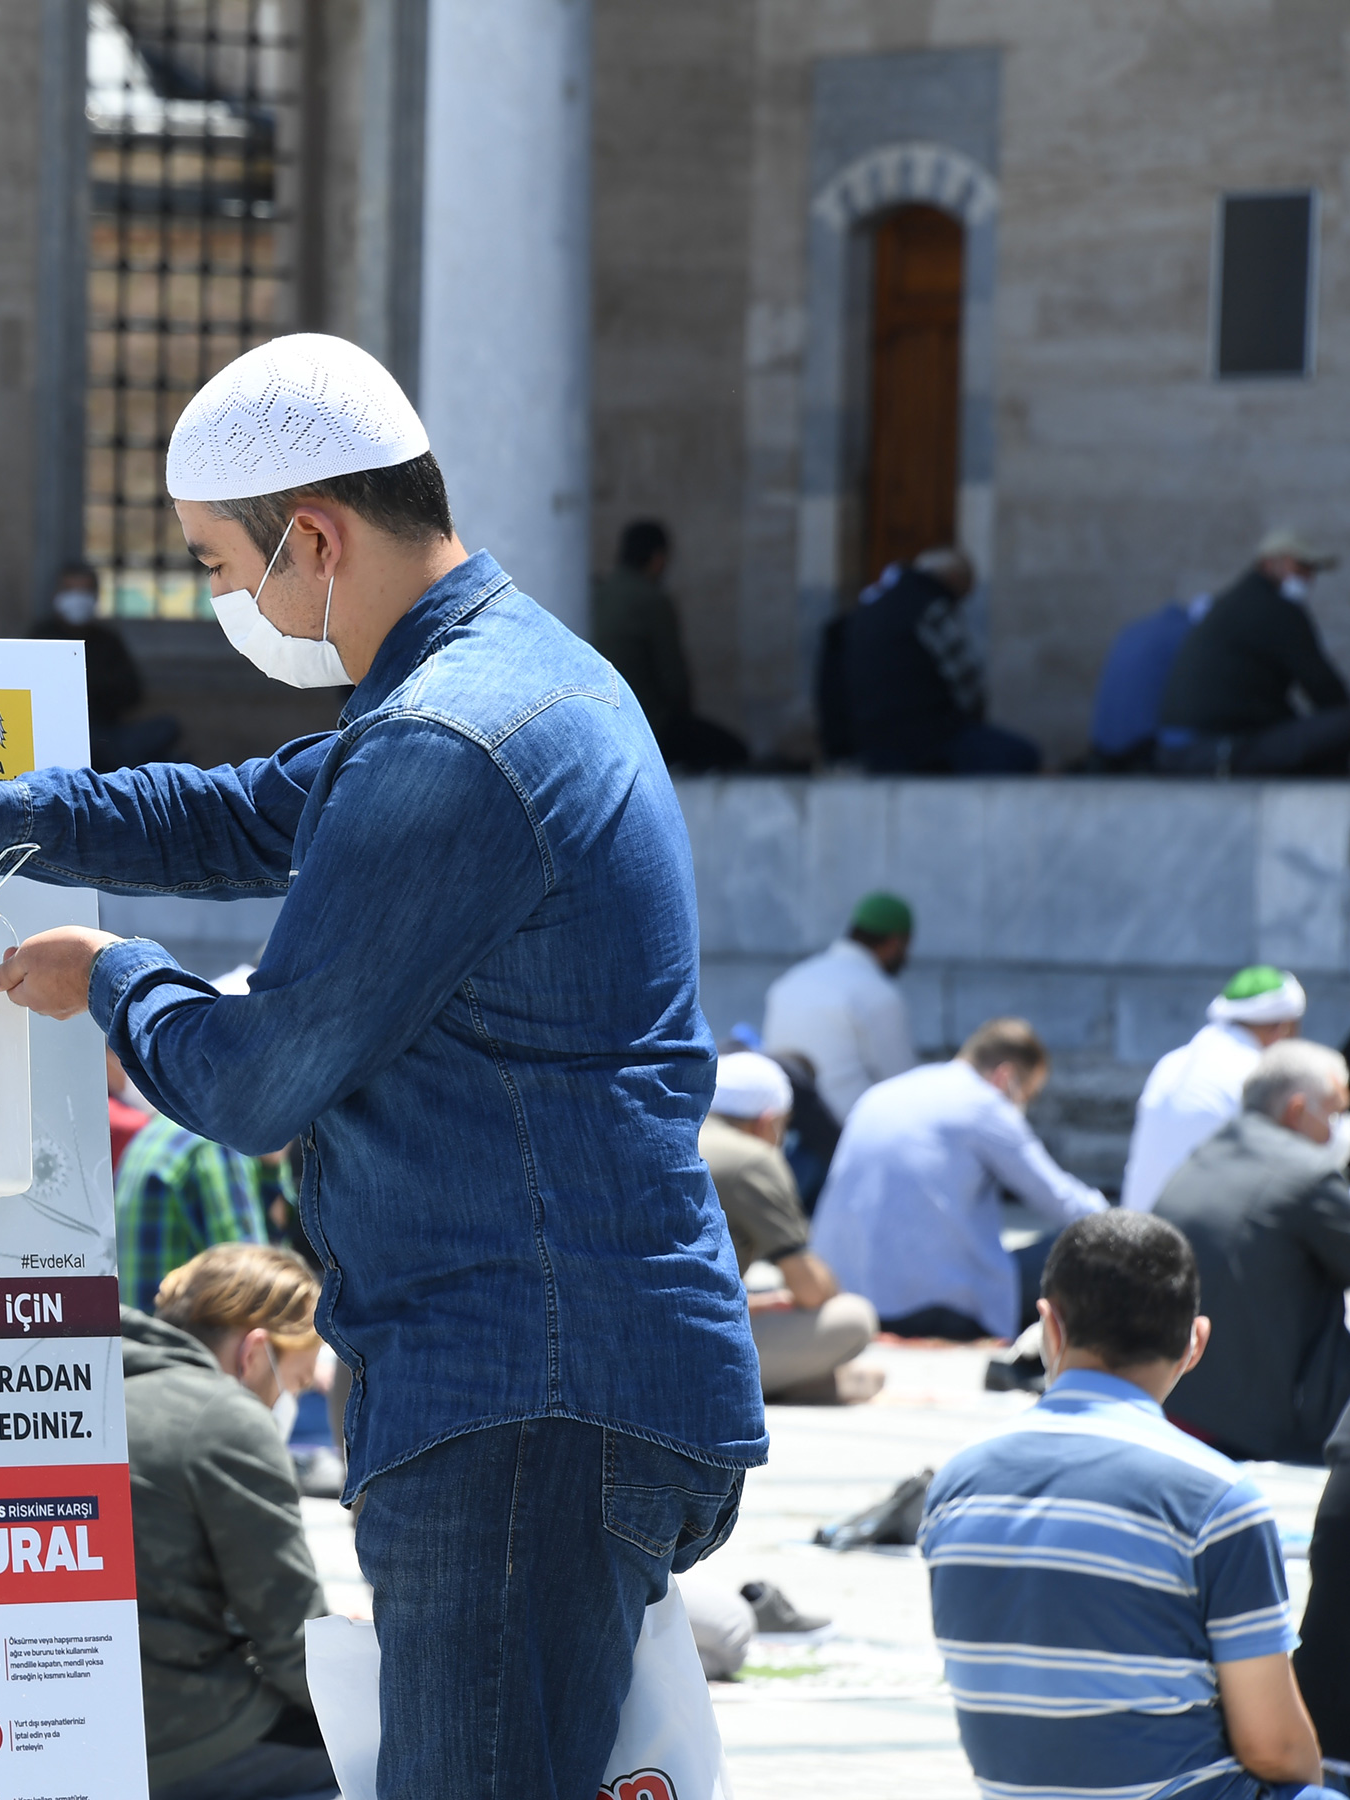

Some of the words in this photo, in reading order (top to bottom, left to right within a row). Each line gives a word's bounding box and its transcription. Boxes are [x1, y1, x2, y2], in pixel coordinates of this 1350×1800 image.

[21, 1254, 85, 1269] #EvdeKal
[8, 1502, 54, 1518] RİSKİNE
[57, 1502, 93, 1519] KARŞI
[39, 1637, 54, 1645] veya
[63, 1659, 84, 1667] mendil
[84, 1659, 104, 1667] yoksa
[40, 1717, 86, 1727] seyahatlerinizi
[15, 1732, 28, 1740] iptal
[16, 1743, 44, 1752] erteleyin
